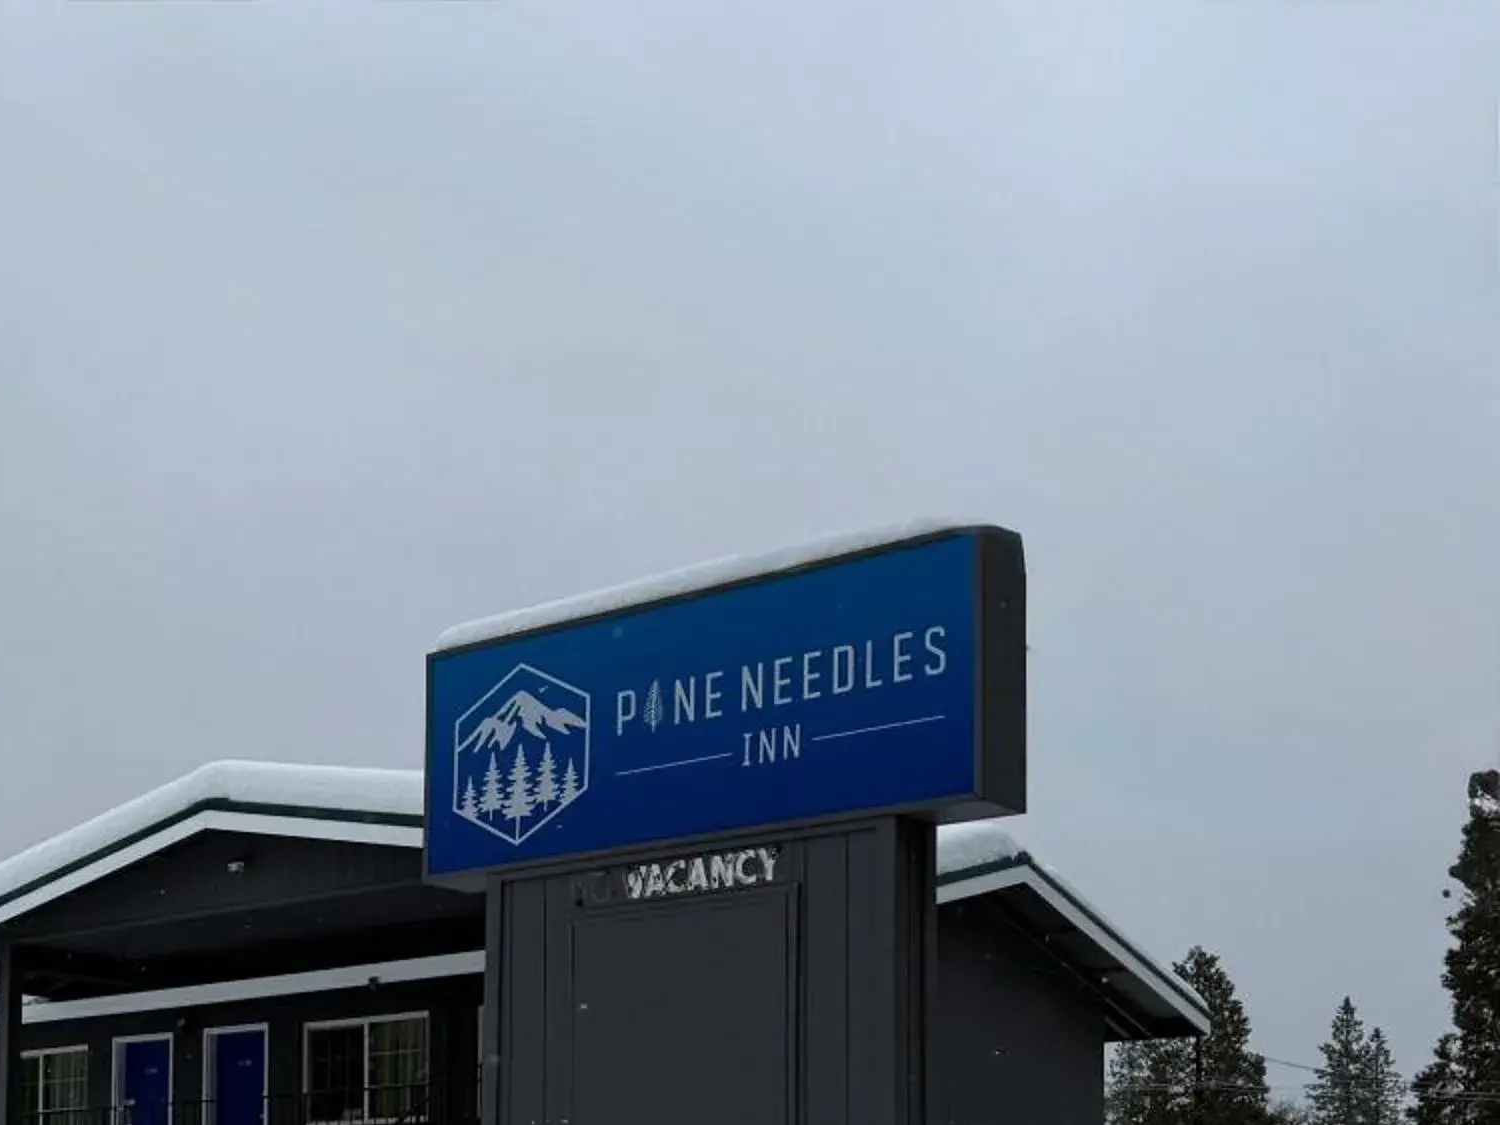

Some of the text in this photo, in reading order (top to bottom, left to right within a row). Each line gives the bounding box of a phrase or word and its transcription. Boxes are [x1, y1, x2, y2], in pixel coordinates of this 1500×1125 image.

[741, 625, 946, 712] NEEDLES
[742, 723, 800, 766] INN
[625, 847, 779, 899] VACANCY
